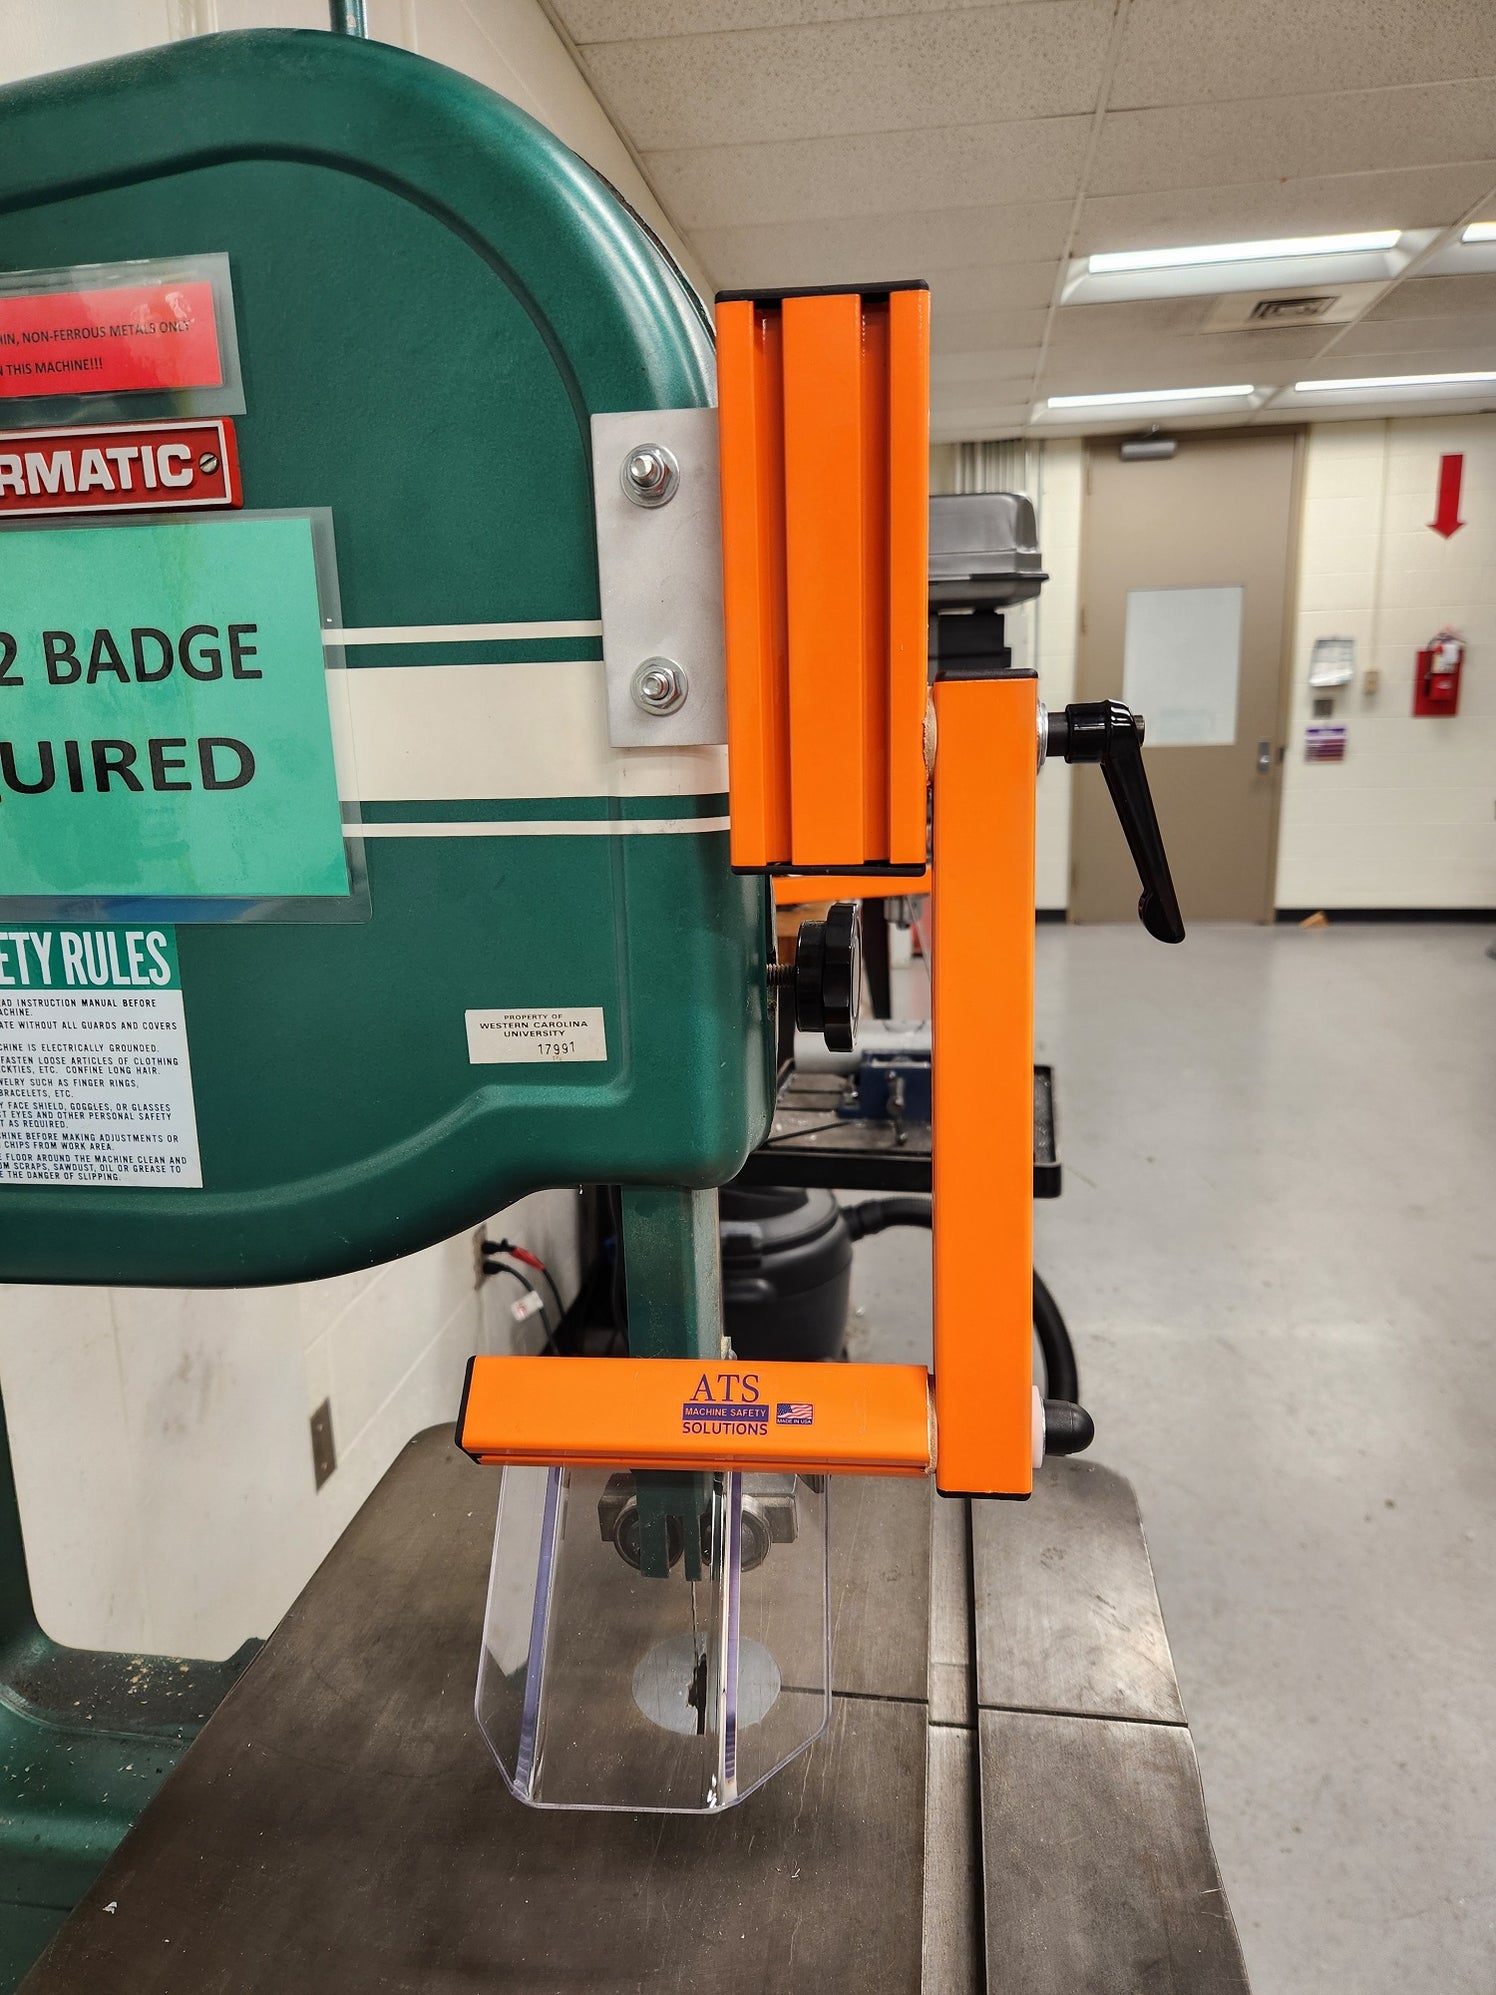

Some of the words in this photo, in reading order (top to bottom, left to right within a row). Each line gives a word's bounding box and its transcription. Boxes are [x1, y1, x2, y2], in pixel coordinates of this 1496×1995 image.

[22, 326, 106, 344] NON-FERROUS
[109, 322, 156, 337] METALS
[159, 319, 190, 333] ONLY
[6, 363, 32, 375] THIS
[35, 357, 103, 373] MACHINE!!!
[0, 444, 193, 496] RMATIC
[0, 631, 24, 686] 2
[43, 624, 263, 685] BADGE
[0, 737, 255, 803] UIRED
[0, 932, 52, 985] ETY
[60, 931, 171, 986] RULES
[17, 999, 76, 1007] INSTRUCTION
[82, 999, 117, 1007] MANUAL
[123, 999, 155, 1007] BEFORE
[18, 1021, 56, 1029] WITHOUT
[63, 1022, 77, 1030] ALL
[82, 1021, 116, 1029] GUARDS
[121, 1022, 138, 1030] AND
[143, 1022, 177, 1030] COVERS
[480, 1022, 529, 1030] WESTERN
[533, 1020, 589, 1029] CAROLINA
[504, 1030, 565, 1038] UNIVERSITY
[28, 1044, 36, 1052] IS
[42, 1044, 103, 1052] ELECTRICALLY
[109, 1044, 159, 1052] GROUNDED.
[538, 1041, 575, 1055] 17991
[39, 1057, 66, 1065] LOOSE
[71, 1057, 113, 1065] ARTICLES
[118, 1057, 128, 1065] OF
[134, 1057, 178, 1065] CLOTHING
[39, 1066, 58, 1074] ETC.
[66, 1066, 103, 1074] CONFINE
[108, 1066, 131, 1074] LONG
[136, 1067, 160, 1075] HAIR.
[30, 1079, 53, 1087] SUCH
[58, 1079, 68, 1087] AS
[74, 1079, 104, 1087] FINGER
[110, 1080, 138, 1088] RINGS,
[55, 1090, 73, 1098] ETC.
[8, 1102, 29, 1110] FACE
[33, 1102, 66, 1111] SHIELD,
[70, 1103, 112, 1111] GOGGLES,
[116, 1103, 127, 1111] OR
[132, 1104, 170, 1112] GLASSES
[0, 1111, 6, 1119] T
[11, 1111, 32, 1119] EYES
[37, 1111, 53, 1119] AND
[57, 1112, 84, 1120] OTHER
[89, 1112, 134, 1120] PERSONAL
[139, 1113, 171, 1121] SAFETY
[9, 1120, 19, 1128] AS
[23, 1120, 68, 1128] REQUIRED.
[0, 1132, 22, 1140] HINE
[26, 1133, 58, 1141] BEFORE
[62, 1134, 95, 1142] MAKING
[100, 1134, 163, 1142] ADJUSTMENTS
[167, 1135, 178, 1143] OR
[4, 1141, 29, 1149] CHIPS
[34, 1142, 57, 1150] FROM
[61, 1142, 86, 1150] WORK
[90, 1143, 114, 1151] AREA.
[6, 1154, 33, 1162] FLOOR
[36, 1154, 70, 1162] AROUND
[74, 1155, 90, 1163] THE
[95, 1156, 133, 1164] MACHINE
[138, 1156, 165, 1164] CLEAN
[170, 1157, 186, 1165] AND
[13, 1163, 51, 1171] SCRAPS,
[54, 1164, 96, 1172] SAWDUST,
[100, 1164, 113, 1172] OIL
[118, 1165, 129, 1173] OR
[133, 1165, 166, 1173] GREASE
[170, 1166, 181, 1174] TO
[7, 1171, 23, 1179] THE
[27, 1172, 60, 1180] DANGER
[64, 1172, 73, 1180] OF
[78, 1173, 121, 1181] SLIPPING.
[690, 1373, 760, 1403] ATS
[685, 1408, 727, 1417] MACHINE
[730, 1408, 767, 1417] SAFETY
[682, 1422, 768, 1436] SOLUTIONS
